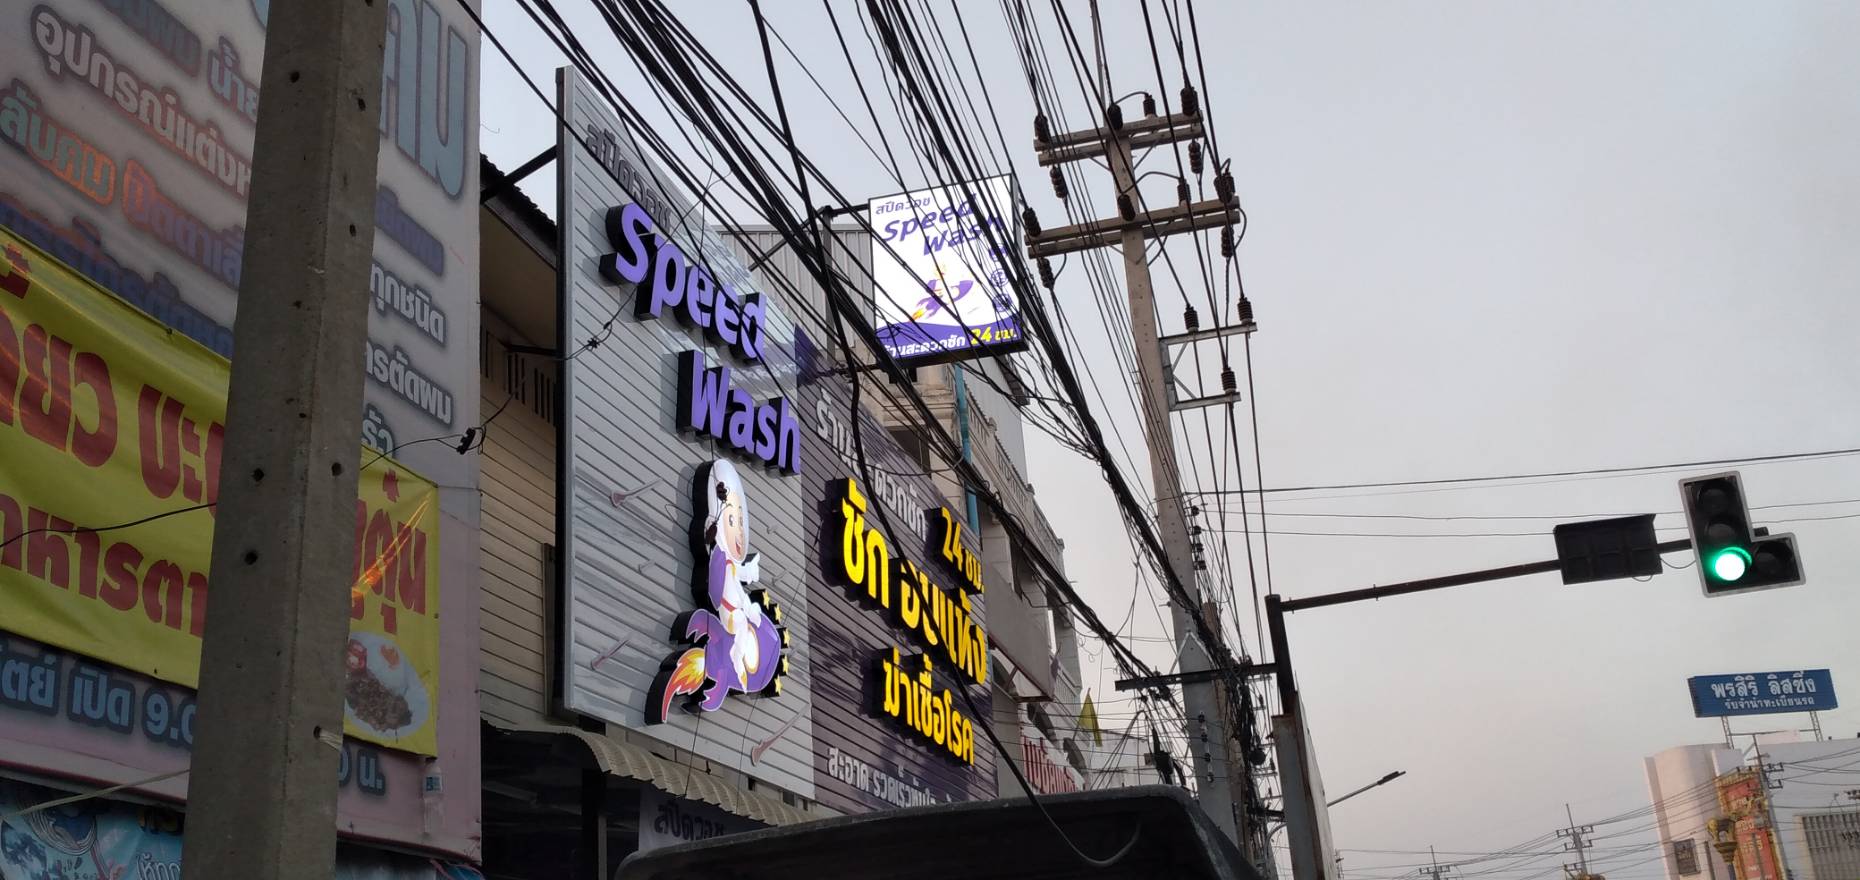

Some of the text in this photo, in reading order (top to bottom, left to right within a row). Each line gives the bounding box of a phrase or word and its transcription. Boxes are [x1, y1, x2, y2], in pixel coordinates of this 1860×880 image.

[612, 202, 766, 361] Speed
[970, 326, 993, 345] 24
[690, 350, 800, 476] Wash
[842, 478, 890, 610] ซัก
[942, 506, 963, 572] 24
[71, 666, 132, 728] เปิด
[882, 647, 976, 766] ฆ่าเชื้อโรค
